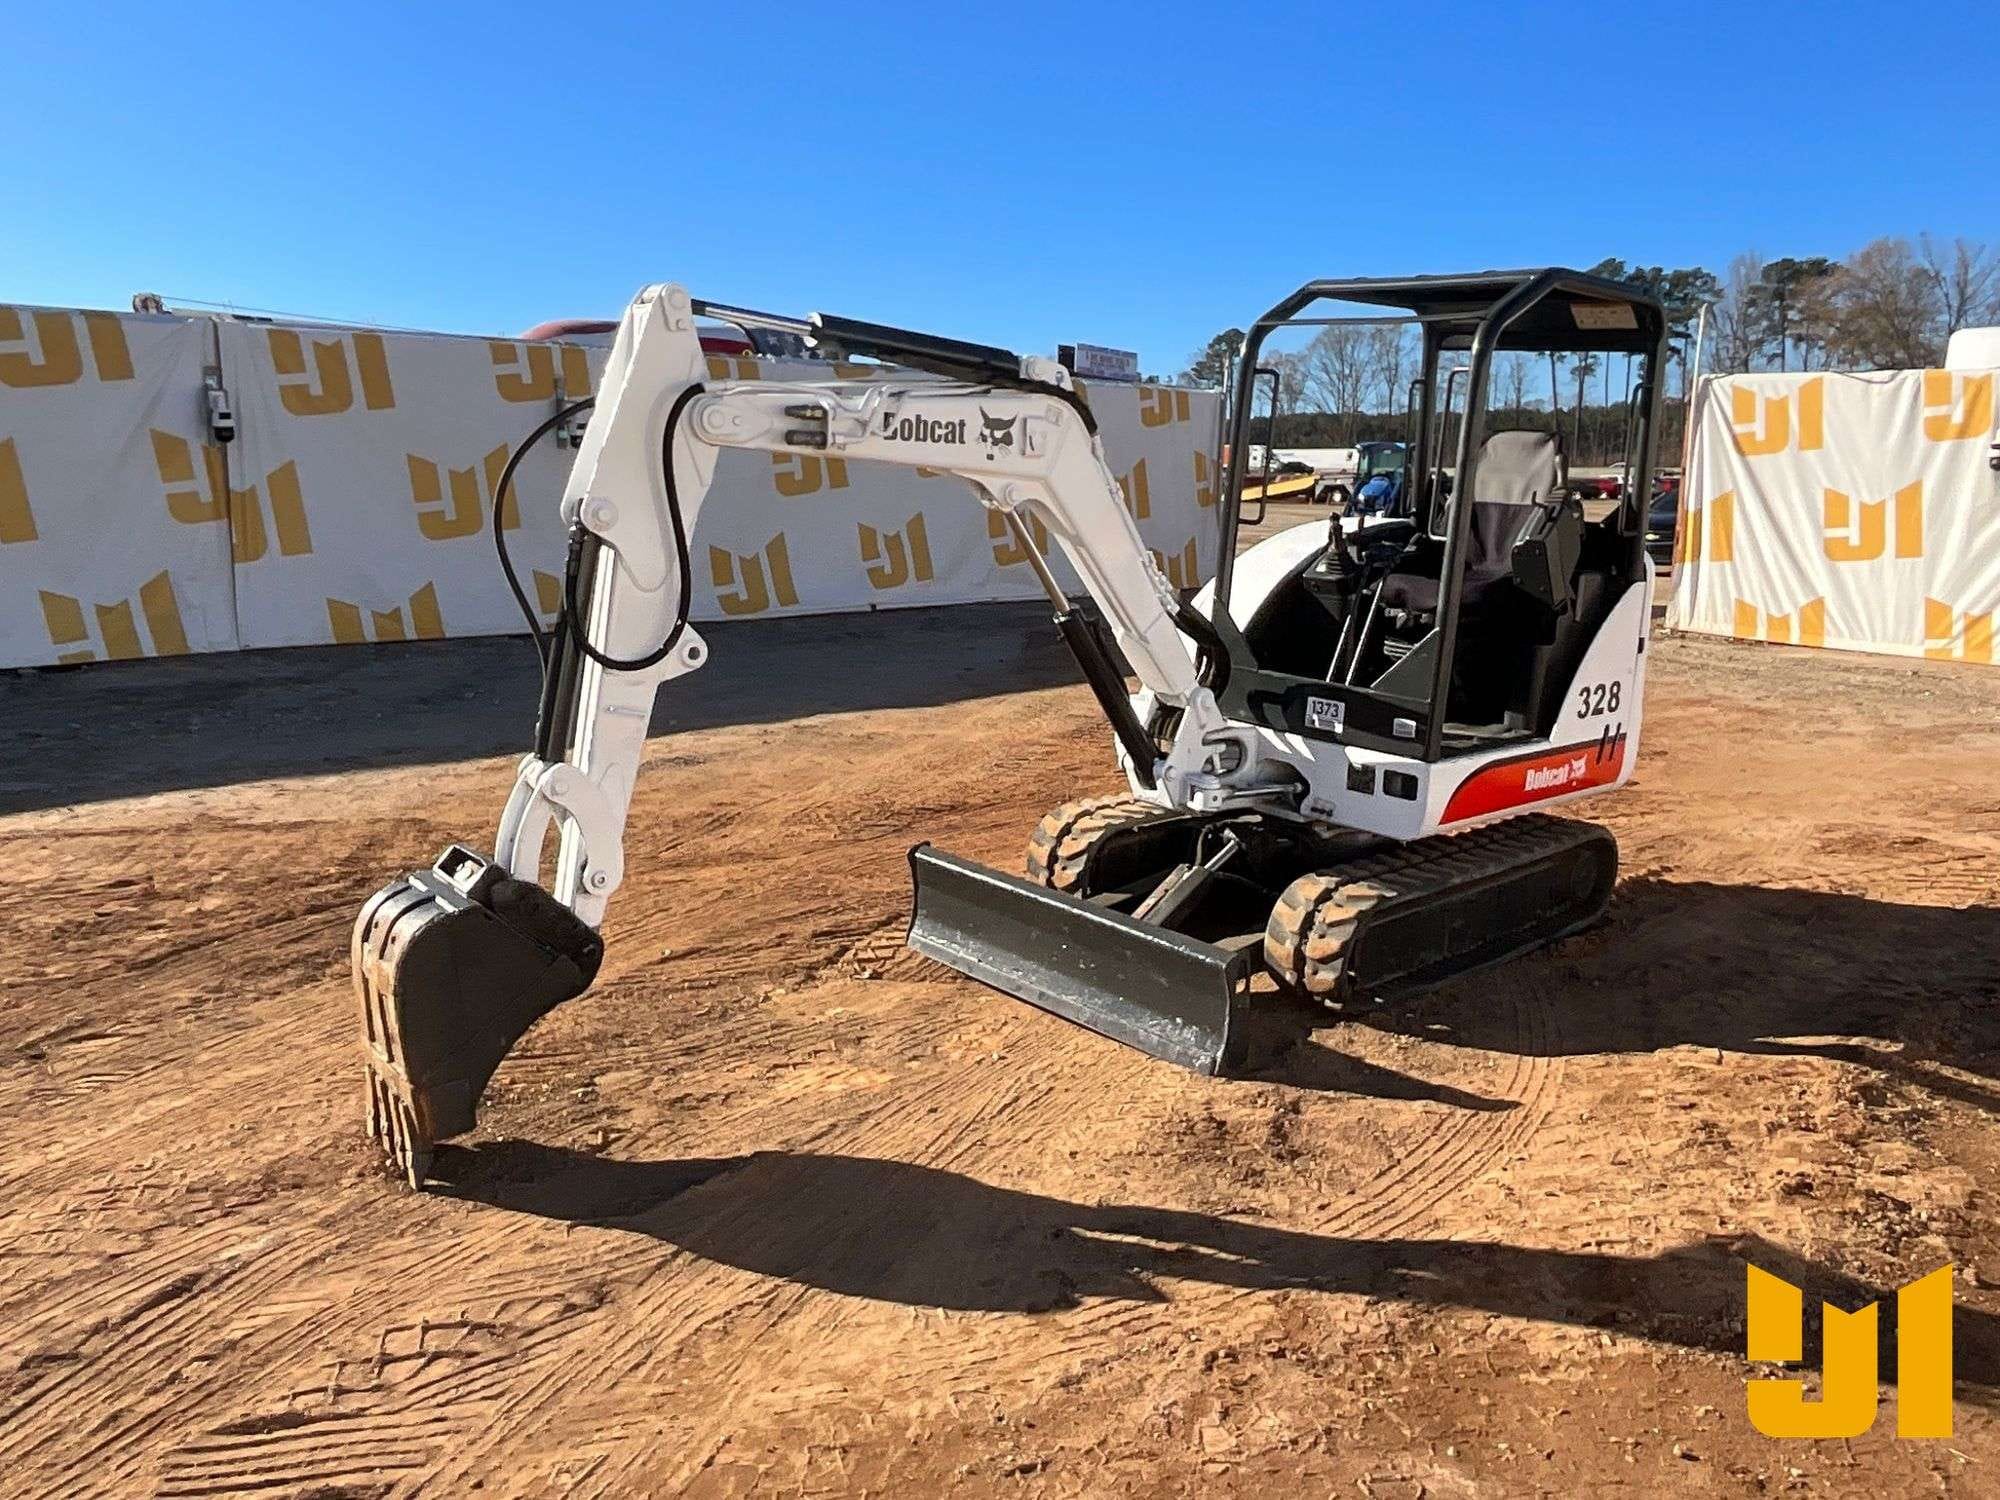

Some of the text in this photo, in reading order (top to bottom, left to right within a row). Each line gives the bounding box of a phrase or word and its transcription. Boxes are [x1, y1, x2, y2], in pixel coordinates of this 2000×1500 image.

[883, 411, 966, 445] Bobcat
[1311, 700, 1340, 718] 1373
[1577, 681, 1622, 719] 328
[1524, 764, 1570, 792] Bobcat
